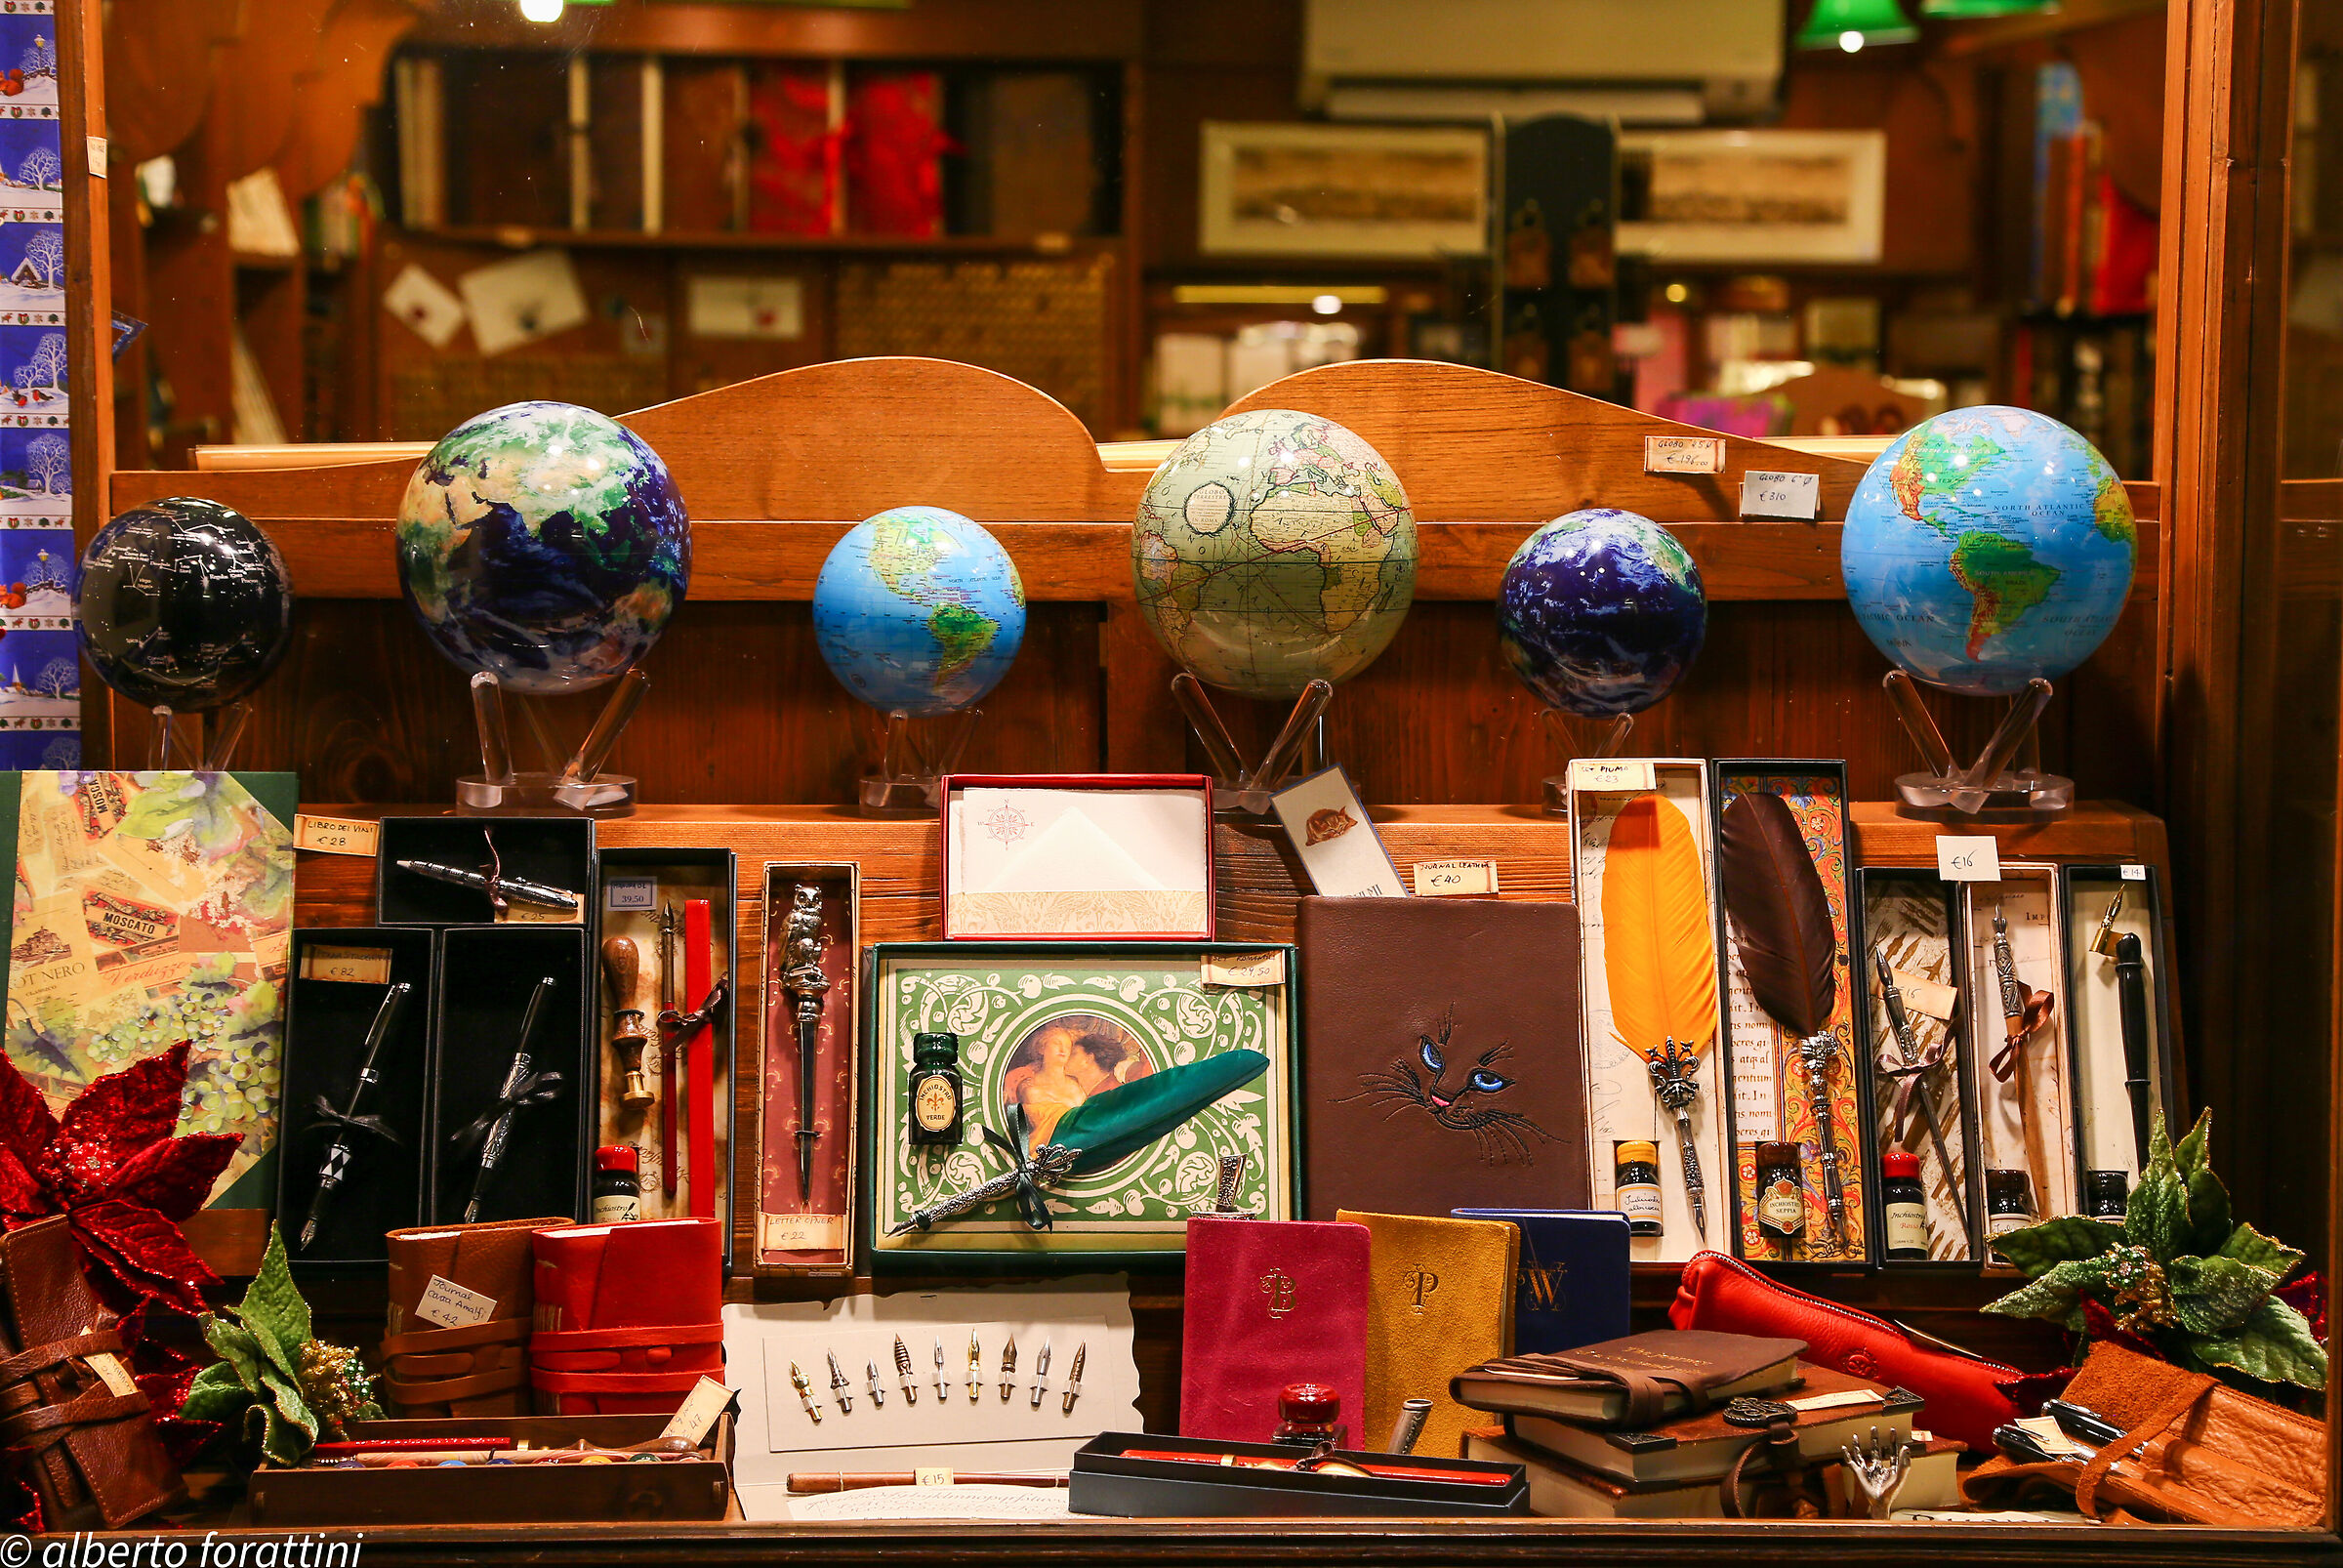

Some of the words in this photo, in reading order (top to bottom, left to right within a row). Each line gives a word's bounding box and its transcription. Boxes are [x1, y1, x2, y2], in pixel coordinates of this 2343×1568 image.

[1759, 474, 1786, 482] GLOBO
[1896, 614, 1935, 623] OCEAN
[308, 821, 336, 831] LIBRO
[103, 912, 155, 934] MOSCATO
[41, 962, 85, 980] NERO
[769, 1217, 802, 1225] LETTER
[1403, 1264, 1439, 1315] P
